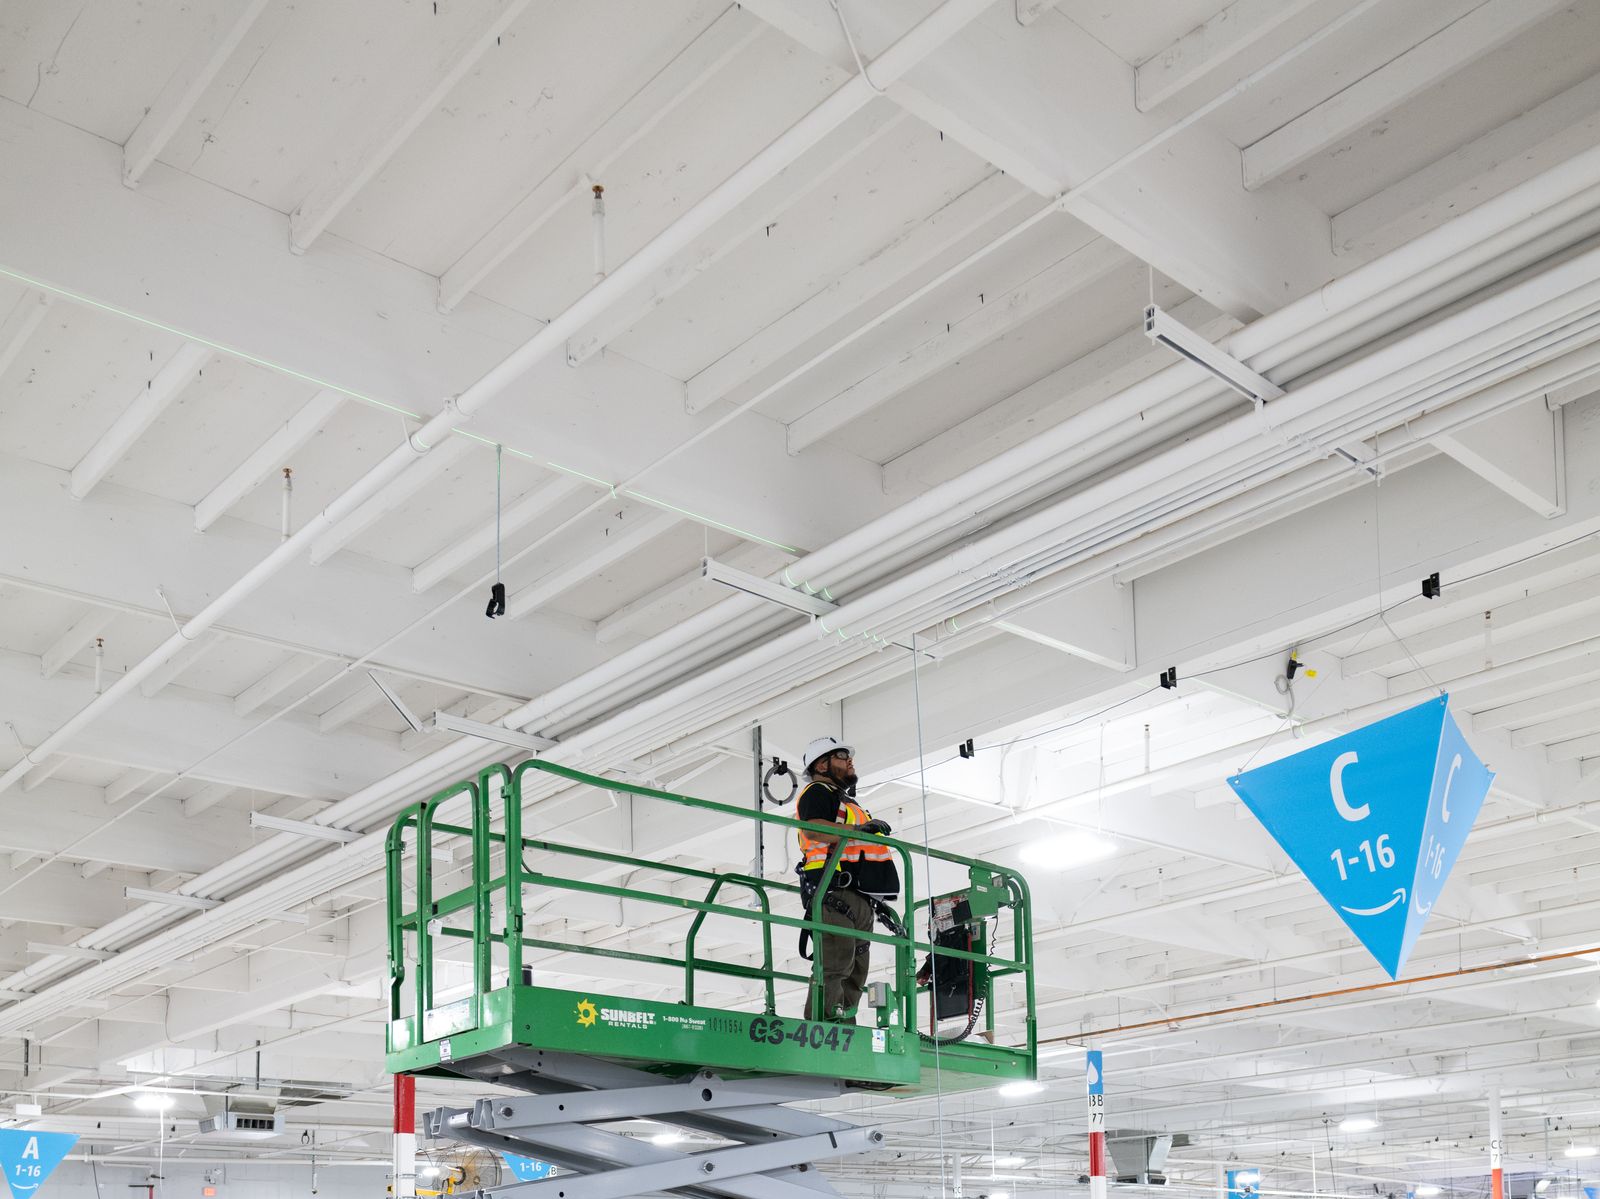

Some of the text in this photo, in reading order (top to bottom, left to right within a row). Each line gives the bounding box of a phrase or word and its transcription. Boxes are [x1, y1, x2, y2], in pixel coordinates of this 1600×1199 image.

[1329, 751, 1371, 822] C
[1441, 753, 1462, 824] C
[1330, 833, 1396, 881] 1-16
[1423, 834, 1447, 880] 1-16
[600, 1008, 655, 1025] SUNBELT
[608, 1021, 648, 1030] RENTALS
[749, 1017, 855, 1053] GS-4047
[21, 1136, 39, 1160] A
[15, 1164, 41, 1177] 1-16
[519, 1162, 542, 1172] 1-16
